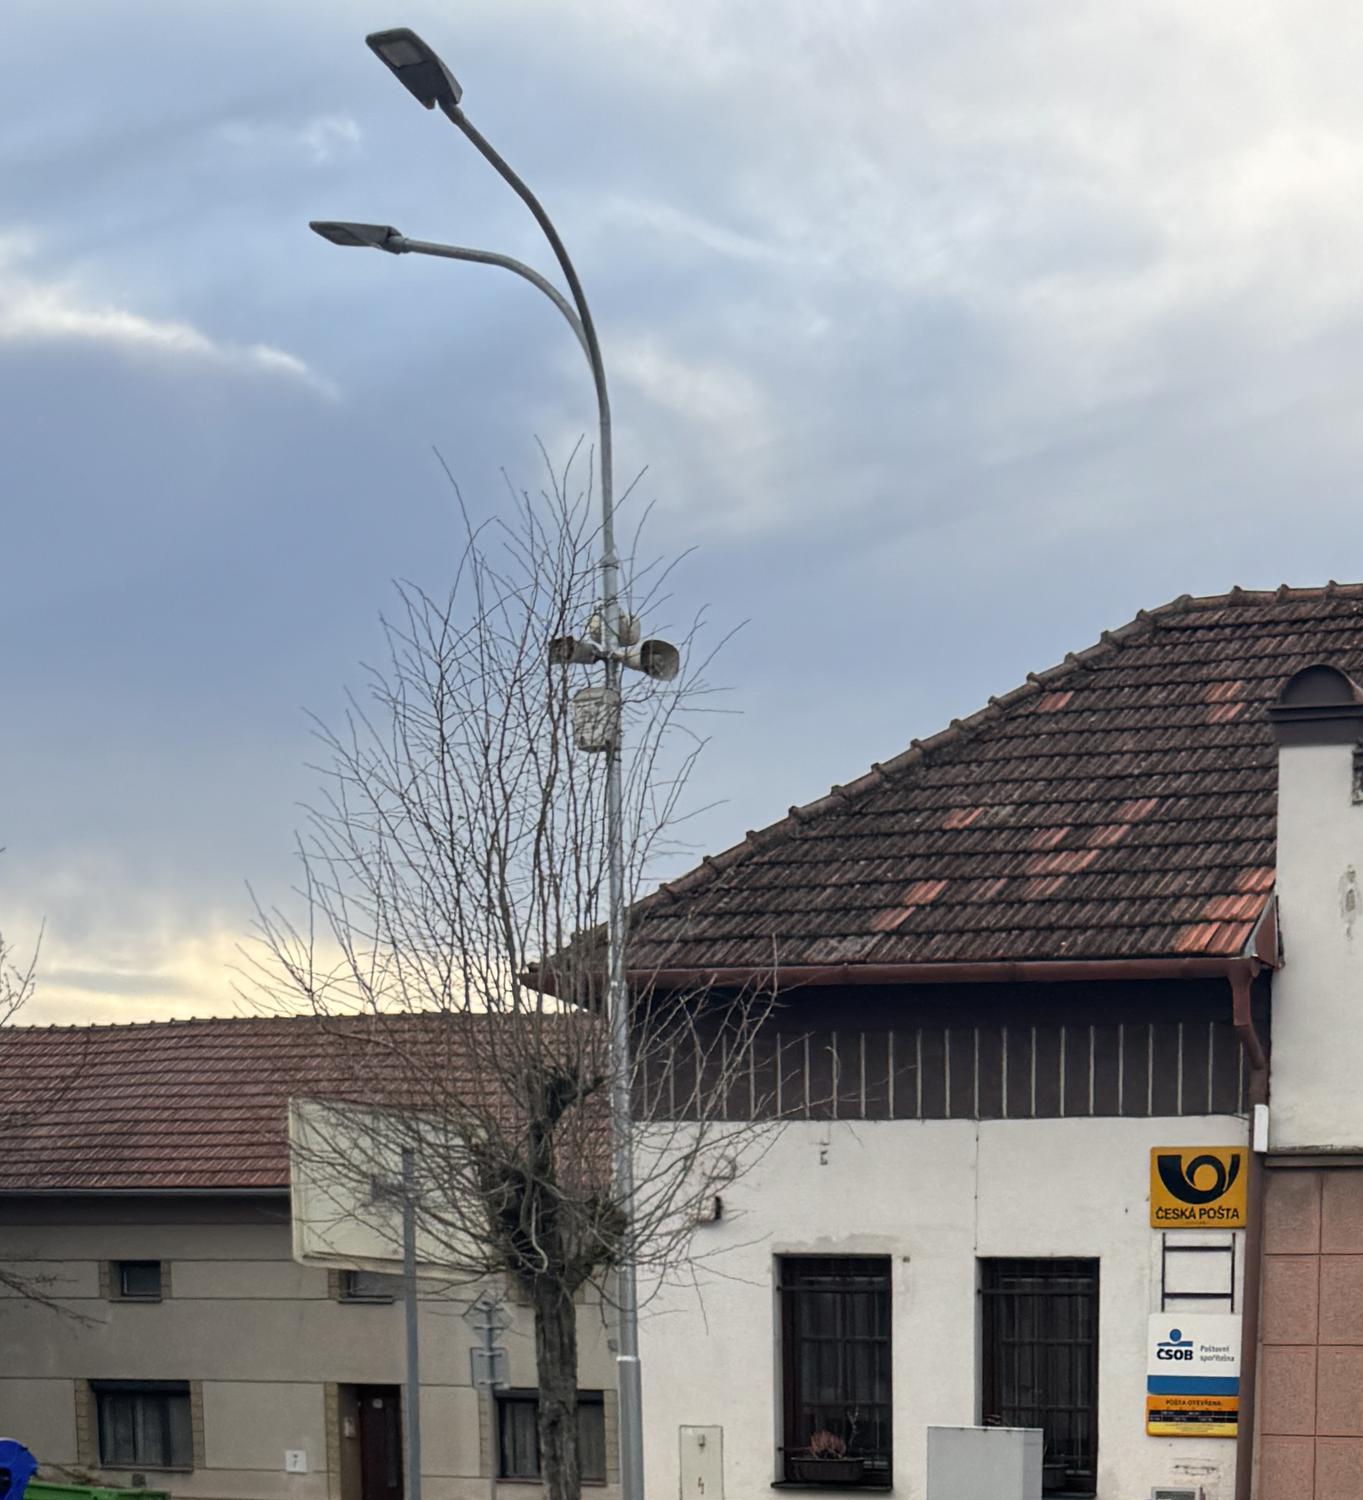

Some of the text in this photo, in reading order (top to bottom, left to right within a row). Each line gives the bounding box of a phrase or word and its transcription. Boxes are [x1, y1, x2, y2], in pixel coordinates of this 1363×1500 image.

[1155, 1206, 1240, 1220] ČESKÁ POŠTA
[1156, 1349, 1194, 1361] ČSOB
